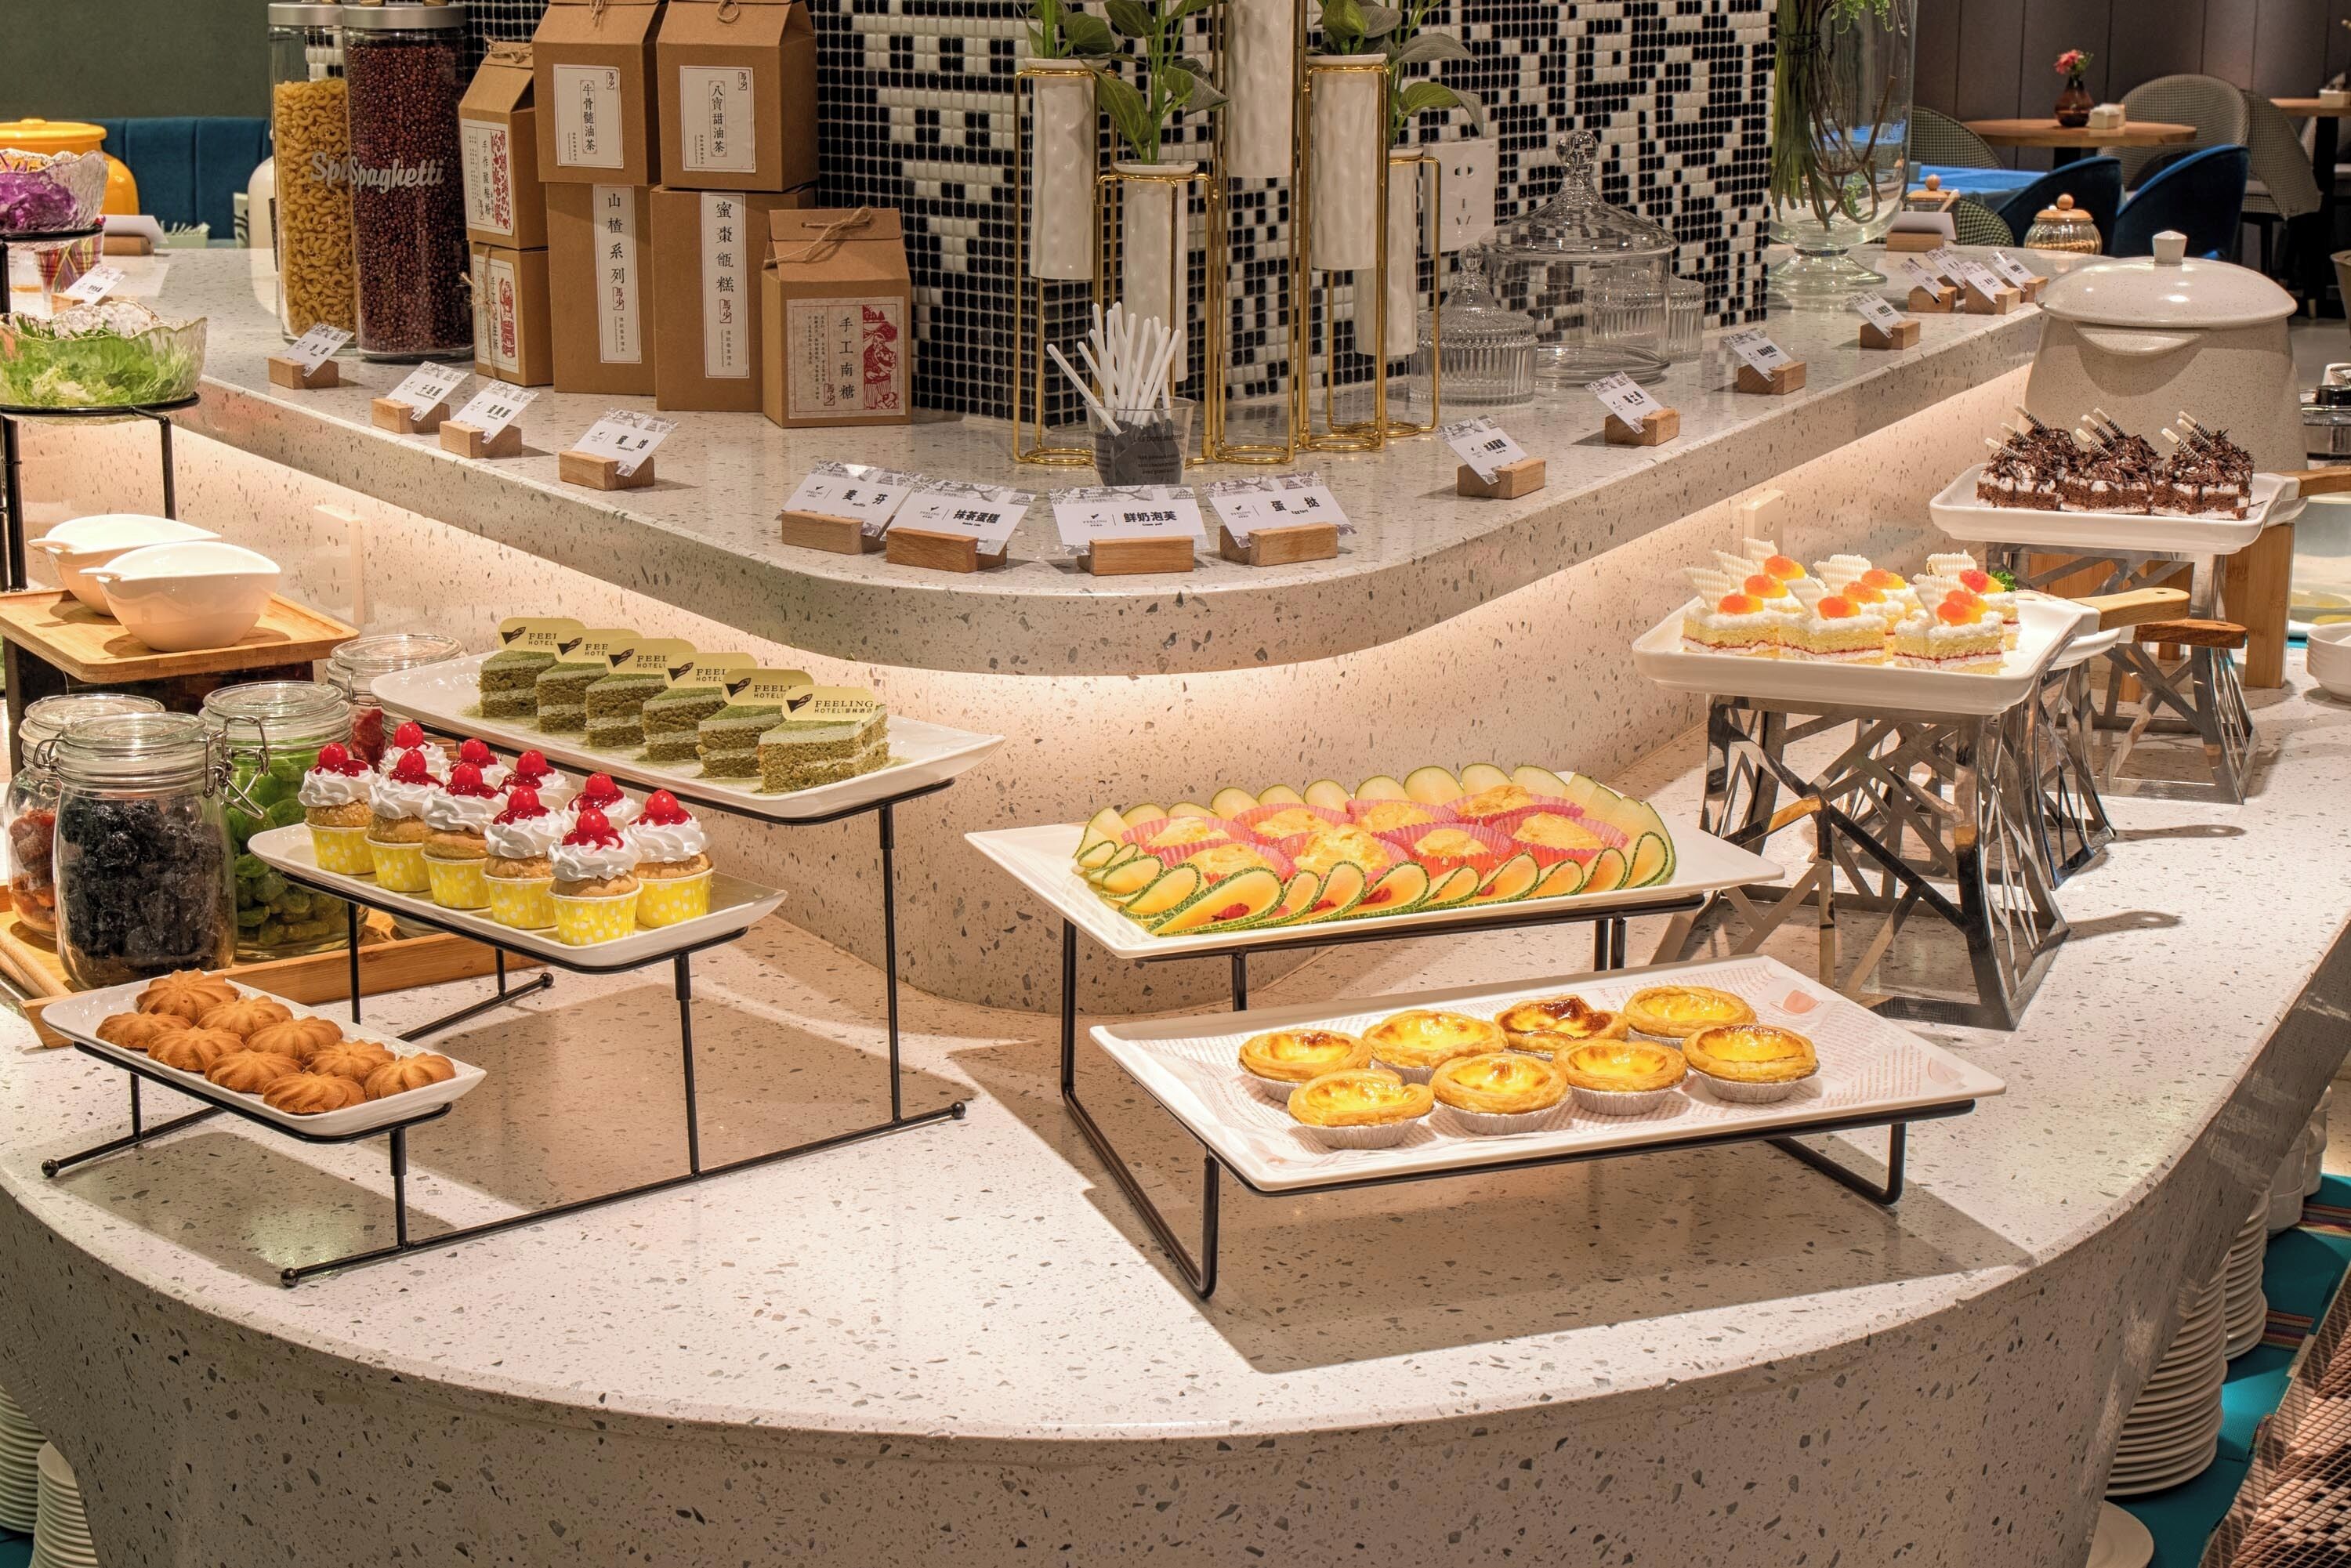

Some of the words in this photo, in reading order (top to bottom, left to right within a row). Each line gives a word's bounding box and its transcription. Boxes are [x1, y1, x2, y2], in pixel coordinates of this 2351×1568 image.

[583, 84, 596, 150] 牛骨髓油茶
[712, 85, 725, 153] 八寶甜油茶
[350, 156, 445, 194] Spaghetti
[607, 193, 625, 284] 山楂系列
[839, 317, 855, 400] 手工南糖
[953, 509, 1000, 523] 抹茶蛋糕
[1123, 511, 1176, 523] 鲜奶泡芙
